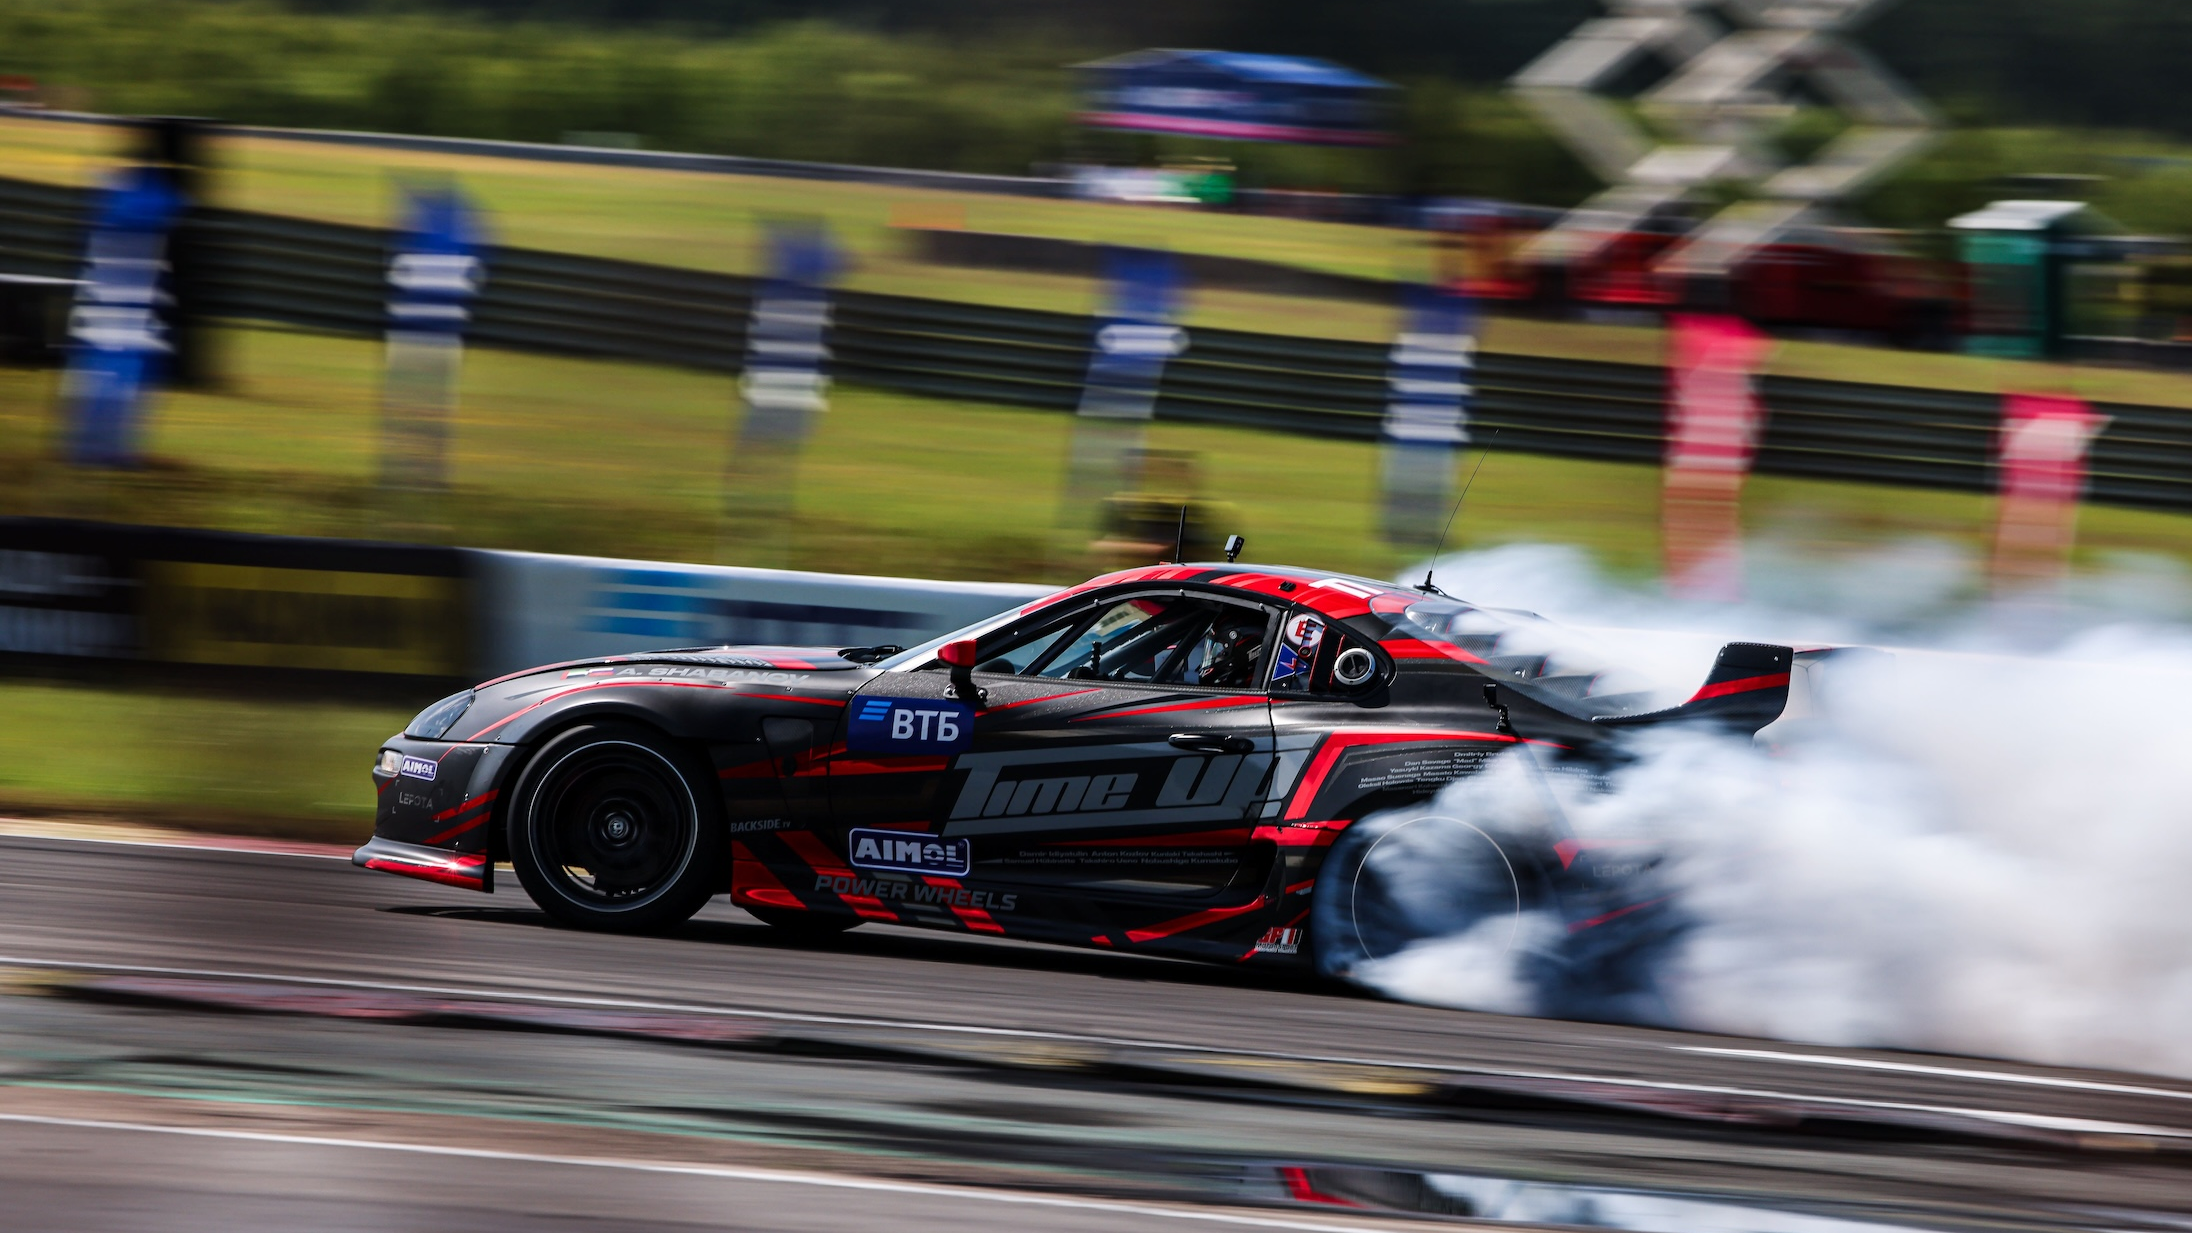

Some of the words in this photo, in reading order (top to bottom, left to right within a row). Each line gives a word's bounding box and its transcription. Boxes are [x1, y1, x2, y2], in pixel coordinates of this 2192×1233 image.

[616, 667, 643, 676] A.
[648, 667, 810, 684] SHABANOV
[892, 708, 960, 741] ВТБ
[403, 760, 434, 775] AIMOL
[730, 818, 781, 833] BACKSIDE
[854, 838, 965, 868] AIMOL
[814, 874, 907, 900] POWER
[914, 884, 1018, 911] WHEELS
